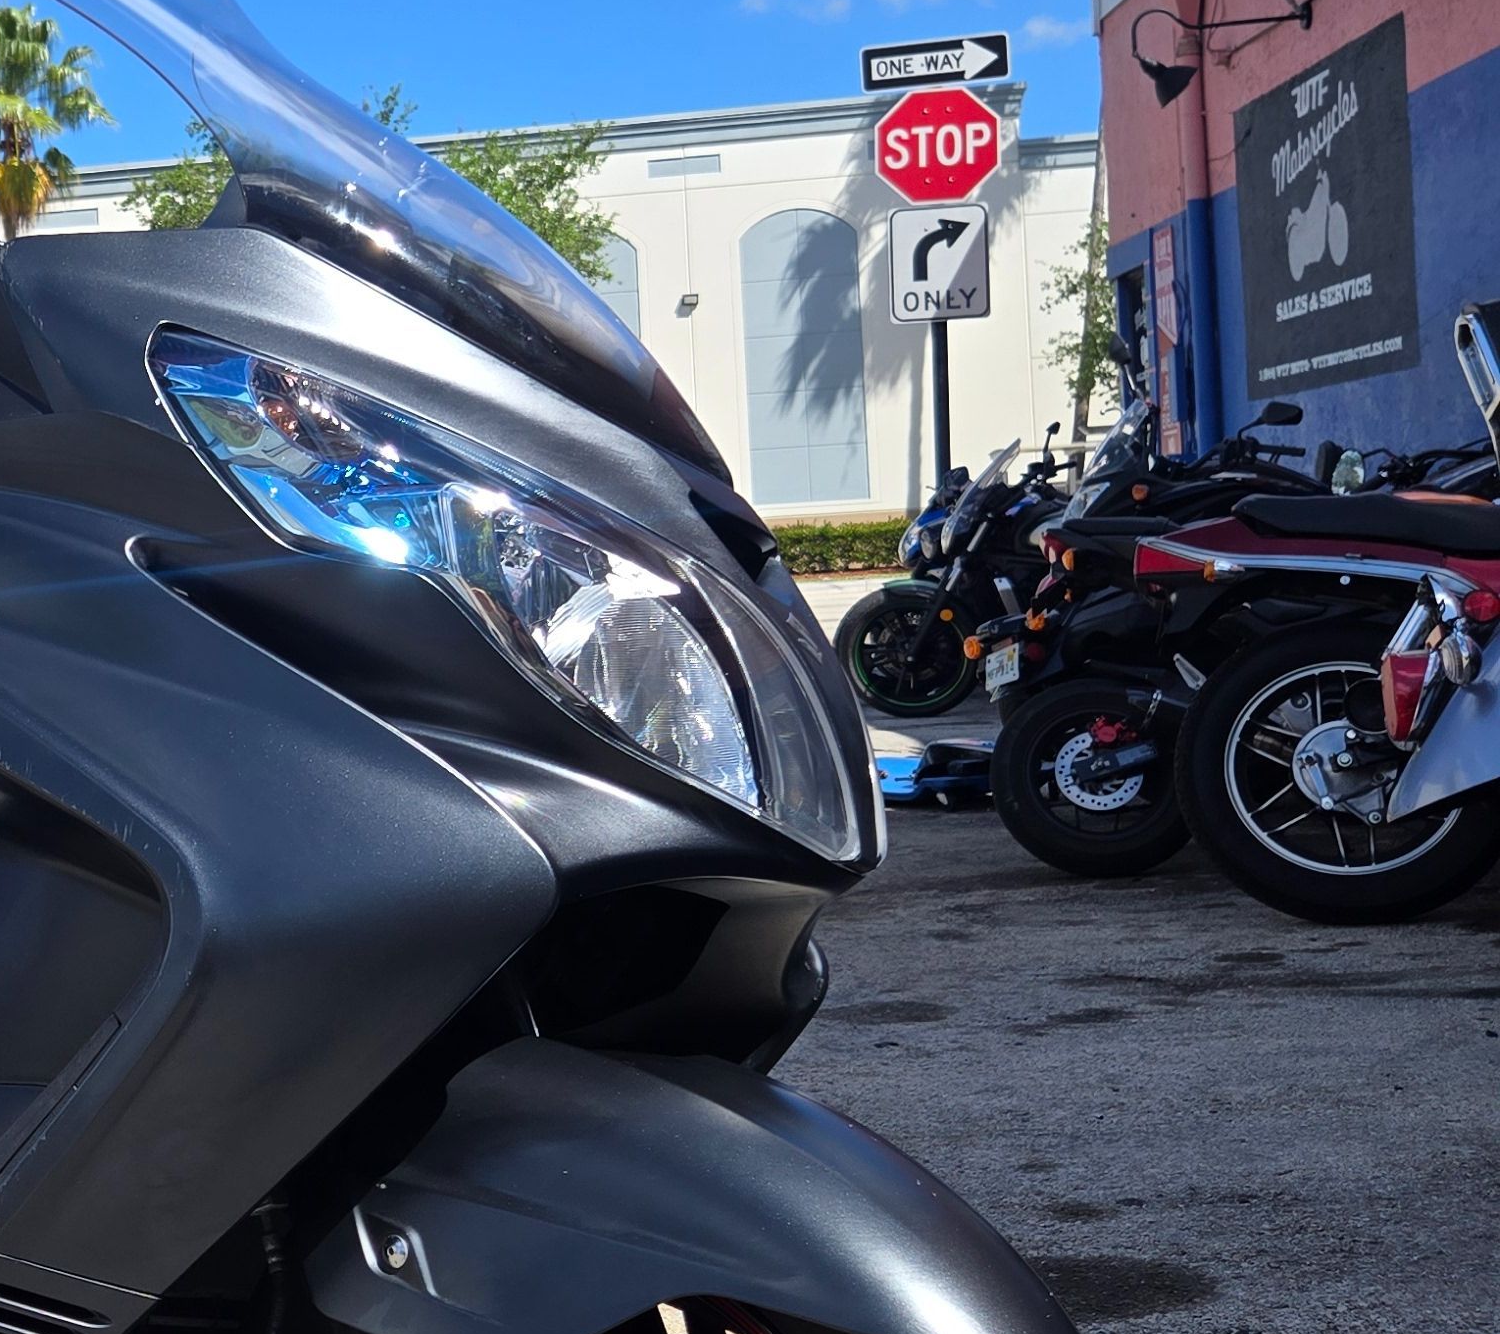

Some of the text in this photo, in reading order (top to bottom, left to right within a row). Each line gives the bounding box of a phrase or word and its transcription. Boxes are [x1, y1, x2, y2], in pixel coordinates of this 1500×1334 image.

[876, 51, 965, 78] ONE WAY
[1290, 69, 1330, 118] WTF
[884, 122, 992, 170] STOP
[1271, 80, 1359, 197] Motorcycles
[902, 287, 977, 313] ONLY
[1275, 273, 1373, 323] SALES & SERVICE
